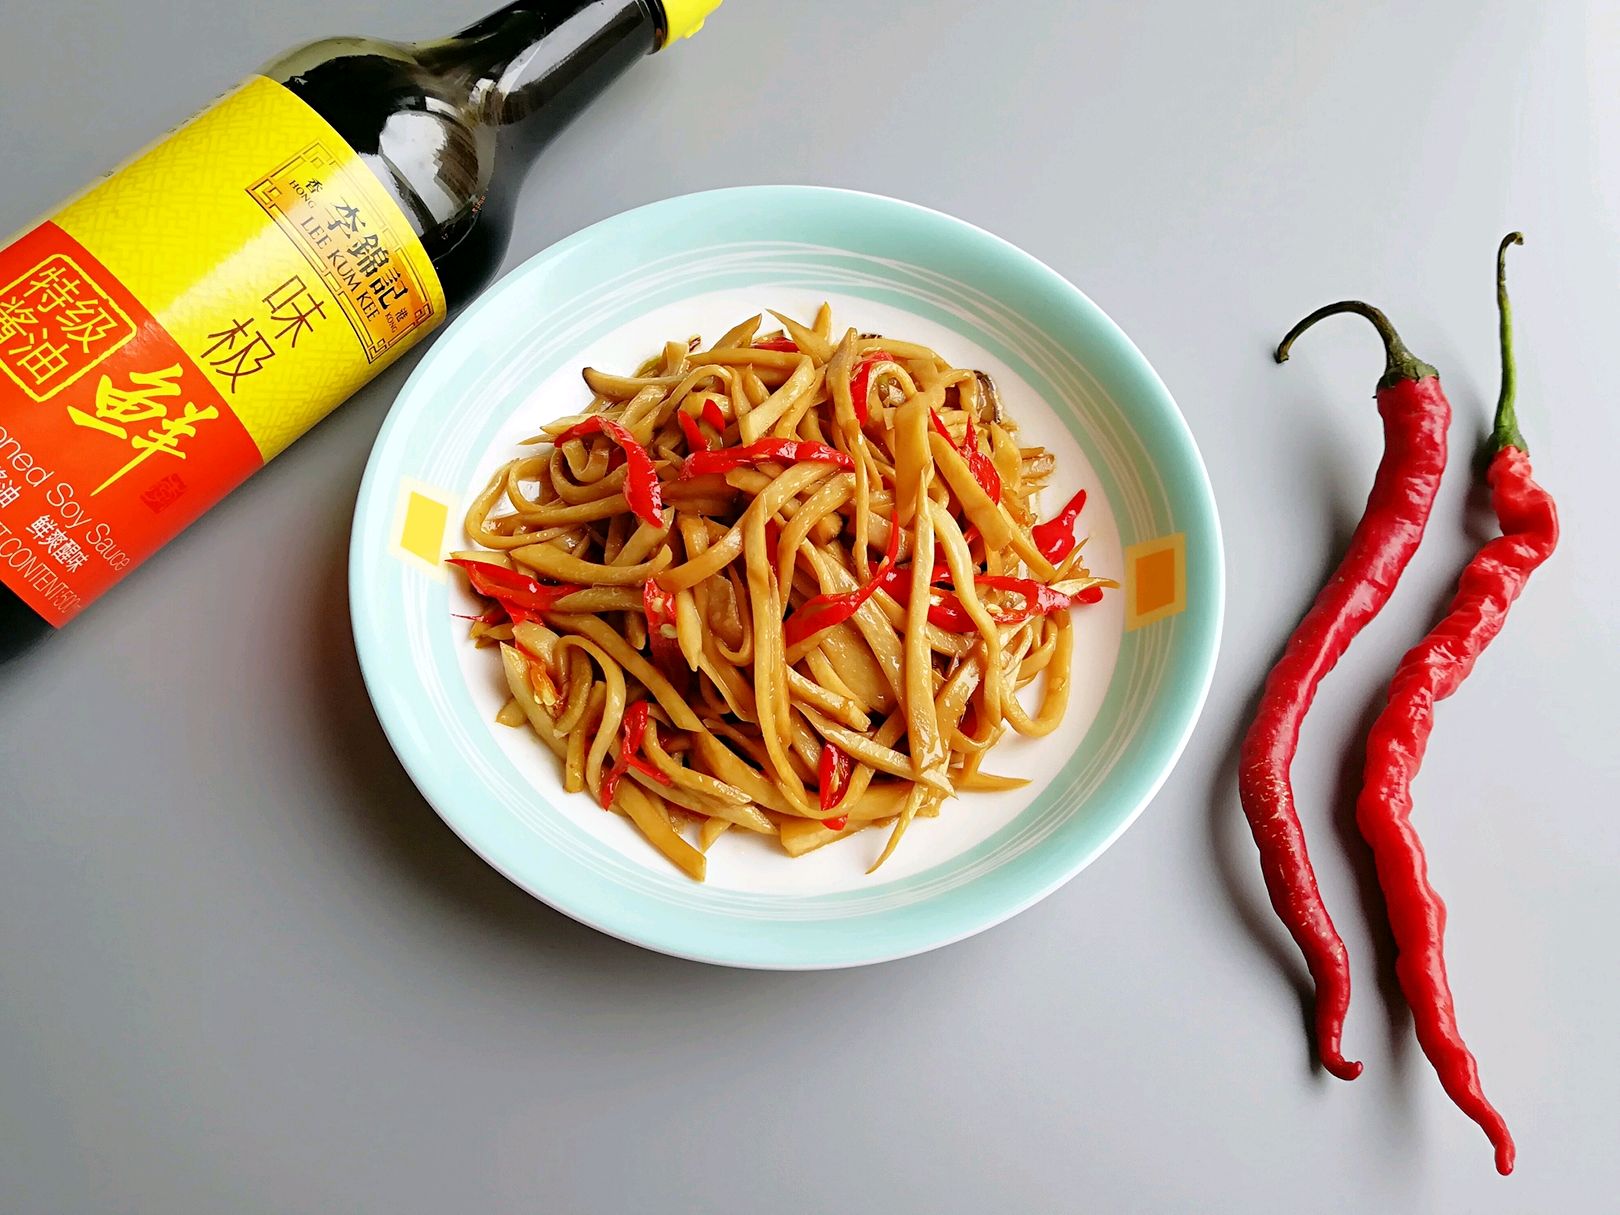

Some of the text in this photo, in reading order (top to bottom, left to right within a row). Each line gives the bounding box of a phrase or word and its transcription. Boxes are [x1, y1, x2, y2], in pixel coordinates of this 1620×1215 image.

[289, 179, 317, 209] HONG
[305, 178, 323, 195] 香
[300, 217, 380, 323] LEE KUM KEE
[327, 196, 409, 310] 李錦記
[23, 267, 118, 353] 特级
[385, 312, 398, 333] KONG
[395, 308, 408, 323] 港
[25, 514, 89, 573] 鲜爽醒味
[46, 482, 92, 529] Soy
[86, 523, 130, 571] Sauce
